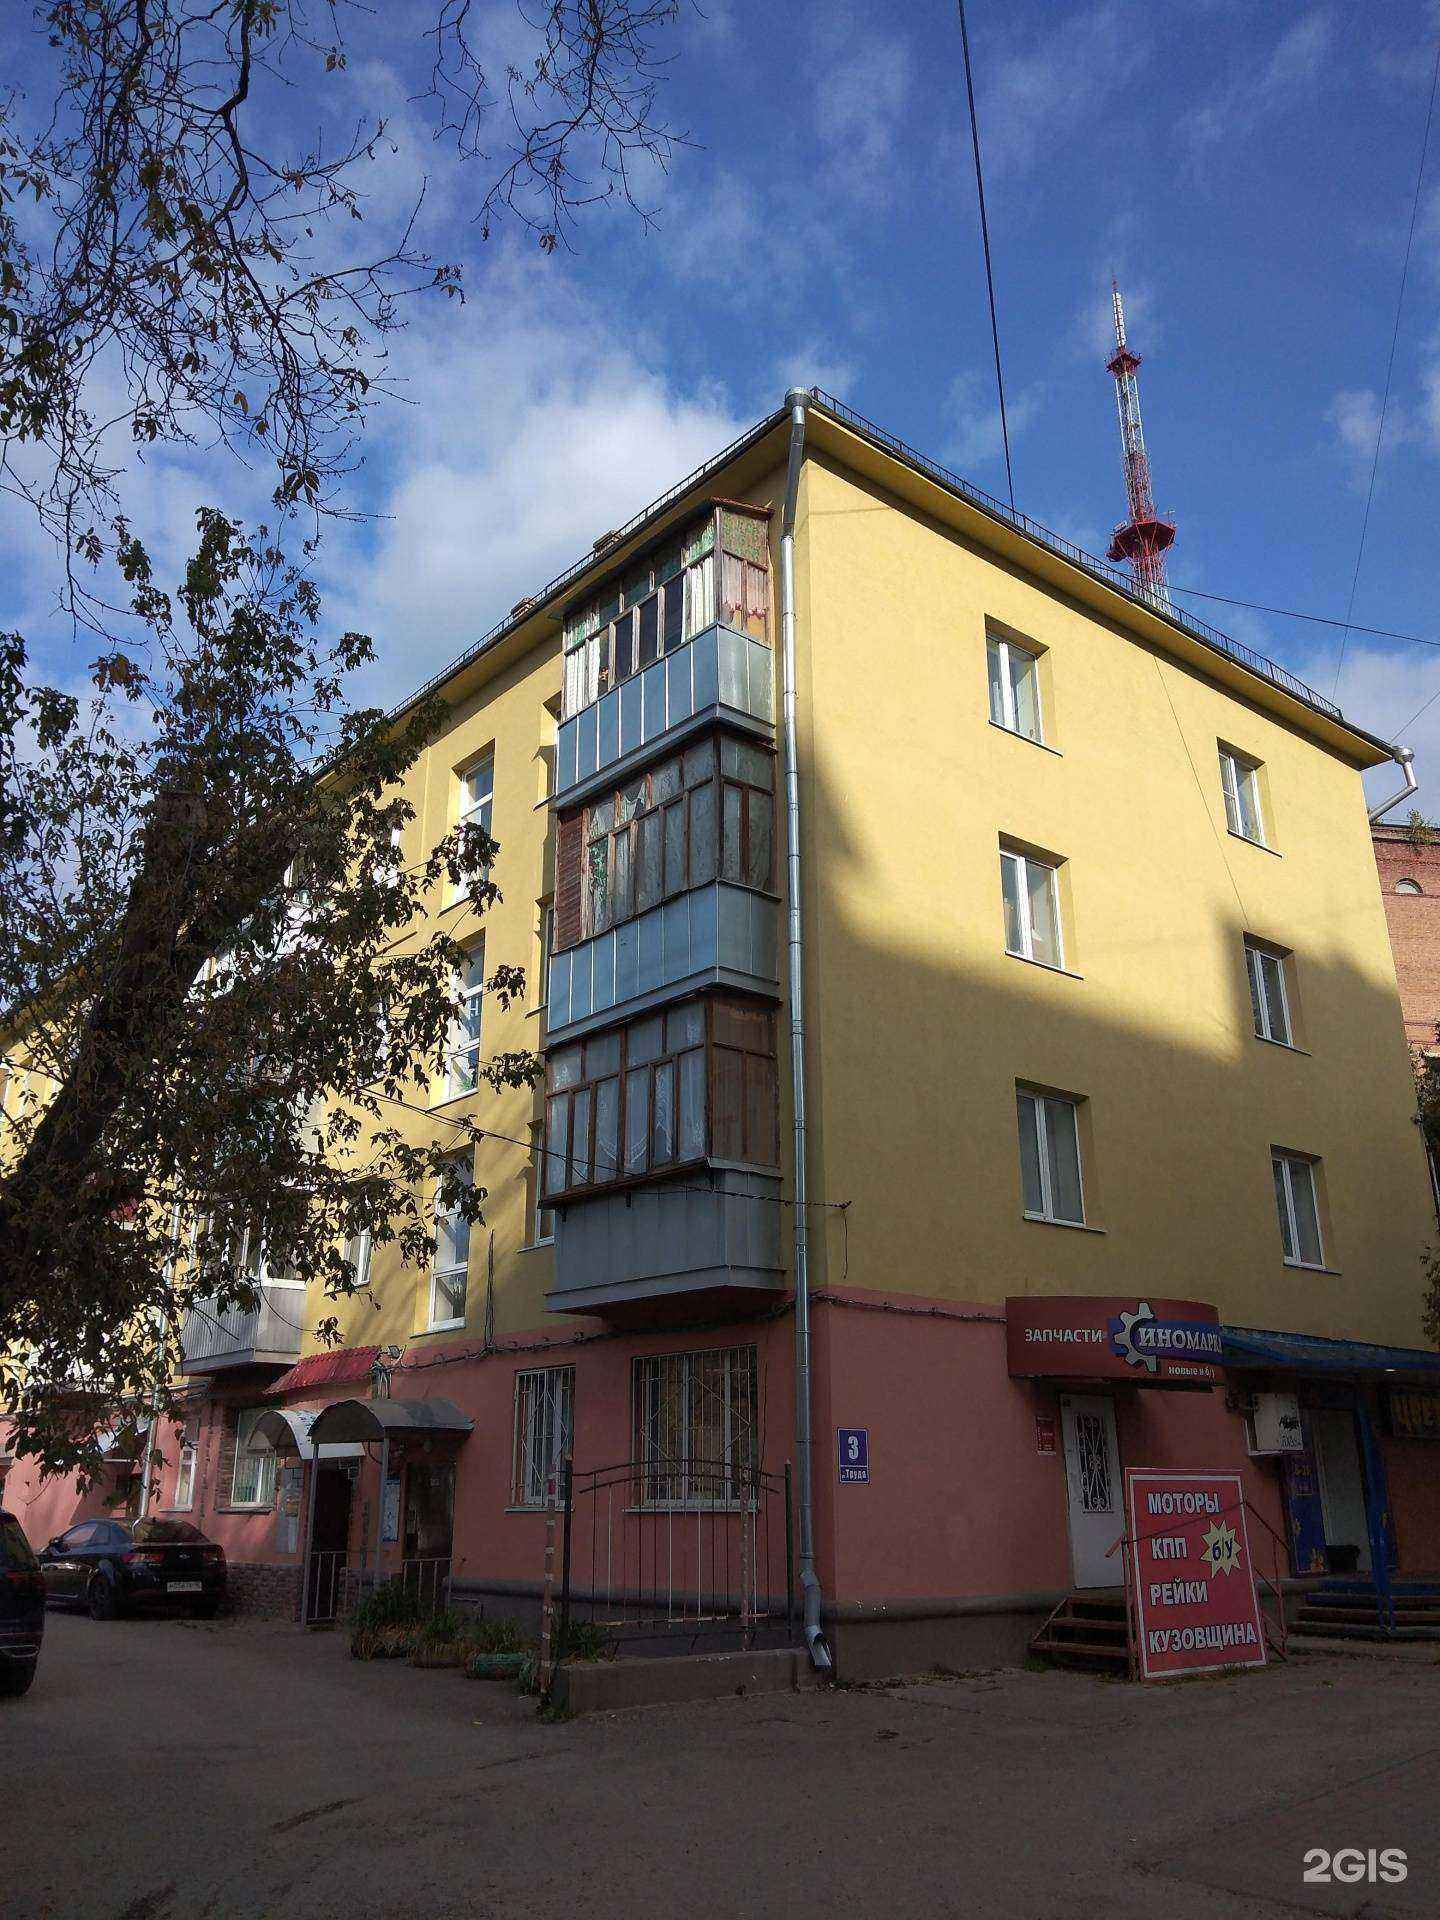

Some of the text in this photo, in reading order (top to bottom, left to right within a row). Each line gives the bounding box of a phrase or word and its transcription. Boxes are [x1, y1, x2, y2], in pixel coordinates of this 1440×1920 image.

[1024, 1327, 1103, 1343] ЗАПЧАСТИ
[1168, 1366, 1198, 1376] новые
[848, 1435, 859, 1460] 3
[1147, 1492, 1220, 1514] МОТОРЫ
[1151, 1537, 1188, 1559] КПП
[1150, 1577, 1208, 1606] РЕЙКИ
[1149, 1622, 1258, 1654] КУЗОВЩИНА
